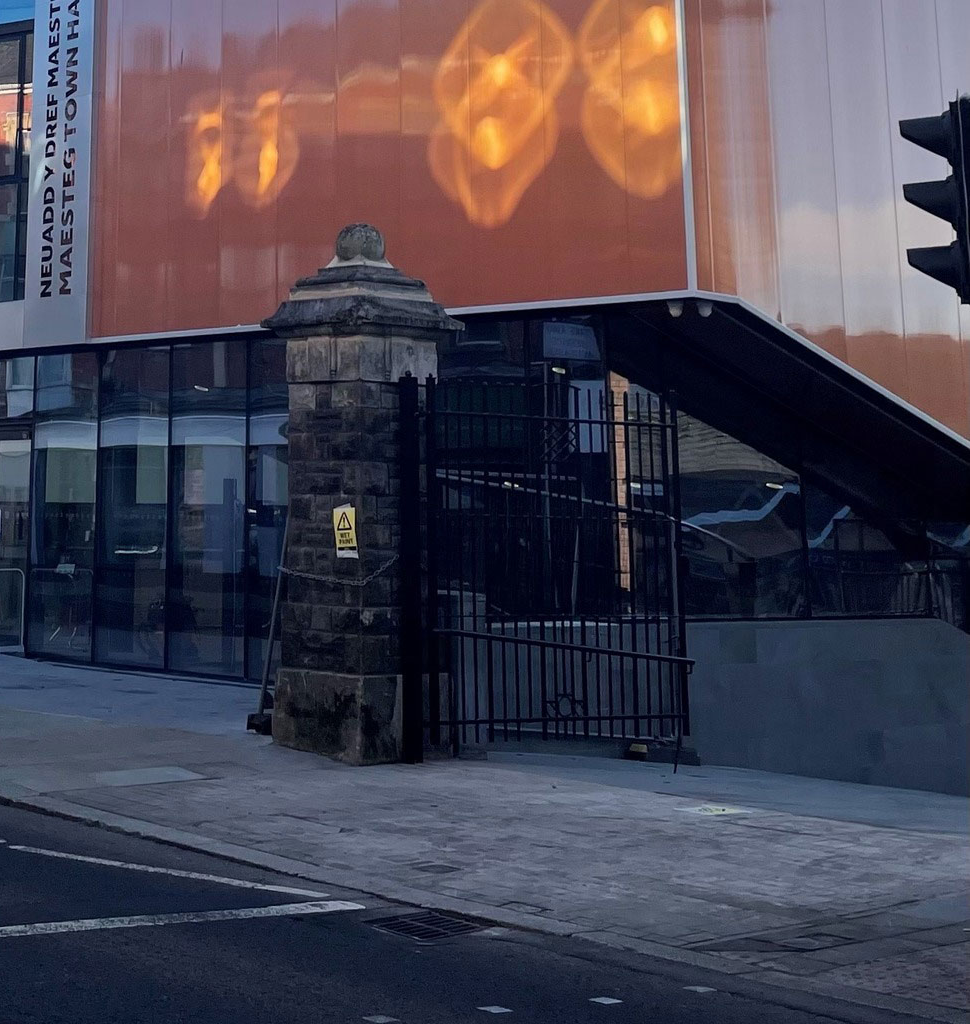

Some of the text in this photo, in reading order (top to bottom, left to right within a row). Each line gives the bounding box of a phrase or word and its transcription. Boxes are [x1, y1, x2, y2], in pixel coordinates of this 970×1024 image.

[45, 93, 58, 158] DREF
[64, 46, 79, 142] TOWN
[44, 165, 56, 182] Y
[59, 147, 76, 295] MAESTEG
[40, 186, 55, 298] NEUADD
